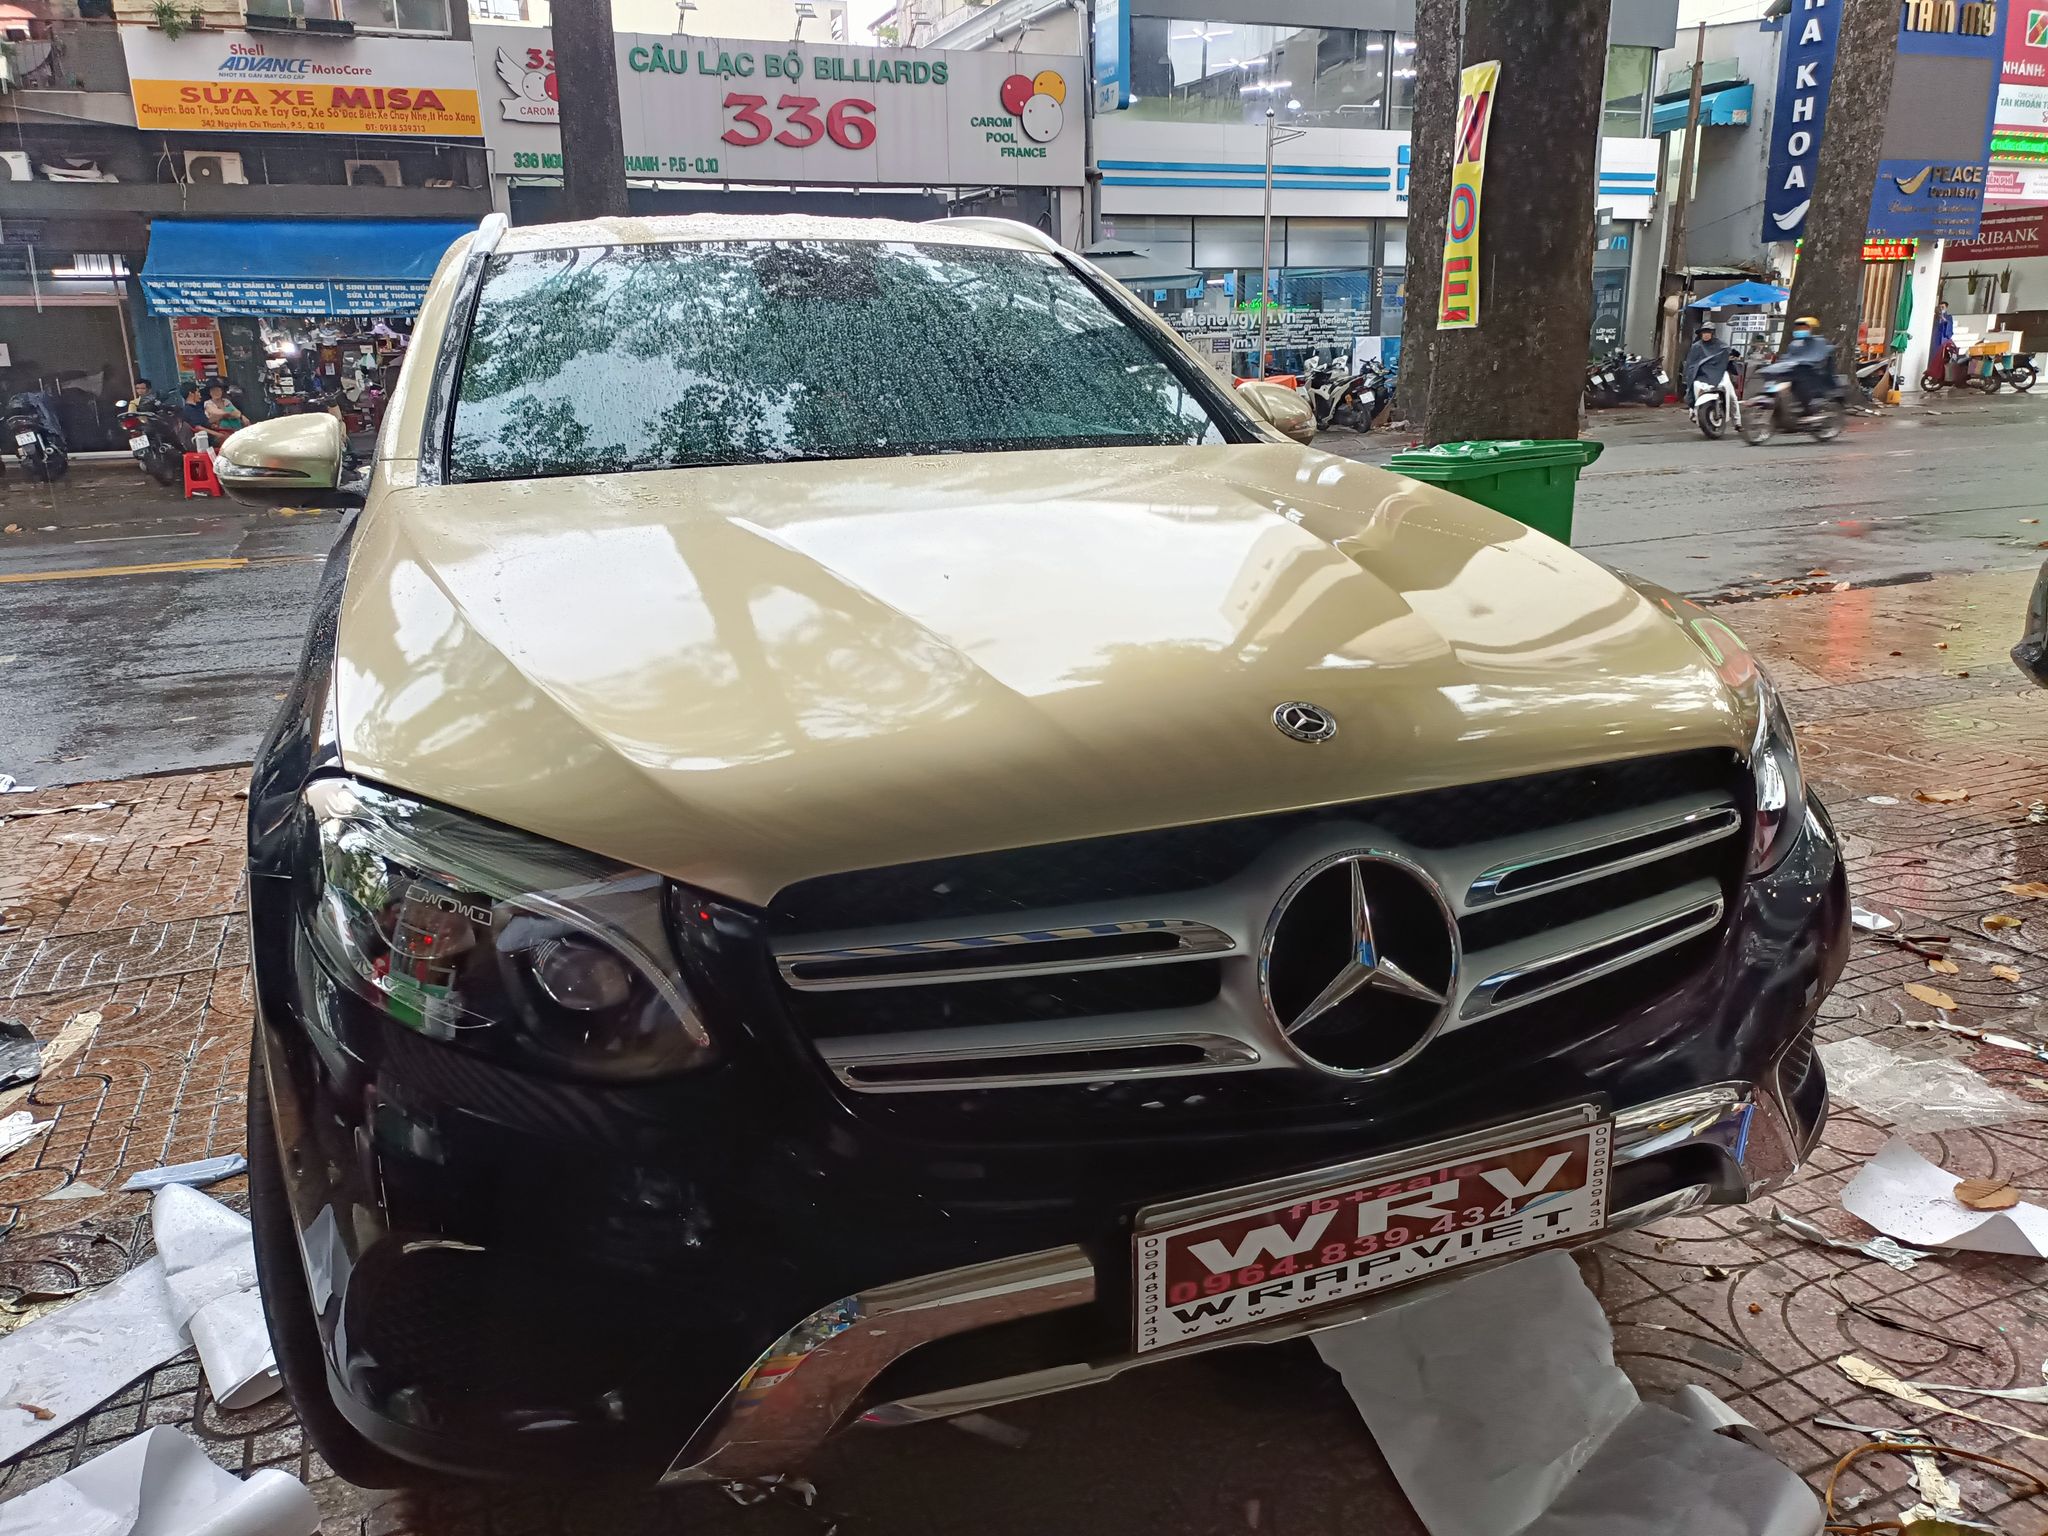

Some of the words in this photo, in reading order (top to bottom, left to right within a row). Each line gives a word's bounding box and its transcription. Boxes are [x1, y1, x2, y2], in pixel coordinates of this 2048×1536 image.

[230, 44, 265, 56] Shell
[526, 48, 557, 70] 33
[218, 56, 312, 73] ADVANCE
[312, 64, 372, 76] MotoCare
[698, 51, 754, 81] LẠC
[764, 50, 804, 84] BỘ
[814, 55, 949, 85] BILLIARDS
[2002, 59, 2045, 77] NHÁNH:
[180, 82, 259, 105] SỬA
[269, 89, 315, 106] XE
[331, 87, 445, 111] MISA
[254, 106, 268, 116] Xe
[270, 106, 290, 119] Tay
[311, 107, 324, 117] Xe
[378, 109, 388, 120] Xe
[437, 111, 454, 121] Hao
[519, 106, 555, 116] CAROM
[721, 91, 877, 150] 336
[970, 116, 1013, 128] CAROM
[1784, 62, 1819, 190] KHOA
[986, 132, 1018, 144] POOL
[513, 152, 539, 169] 336
[695, 157, 719, 174] Q.10
[1000, 147, 1047, 158] FRANCE
[1931, 166, 1984, 183] PEACE
[1187, 1151, 1574, 1275] WRV
[1169, 1198, 1516, 1304] 0964.839.434
[1172, 1207, 1573, 1324] WRAPVIET
[1144, 1238, 1159, 1346] 0964839434
